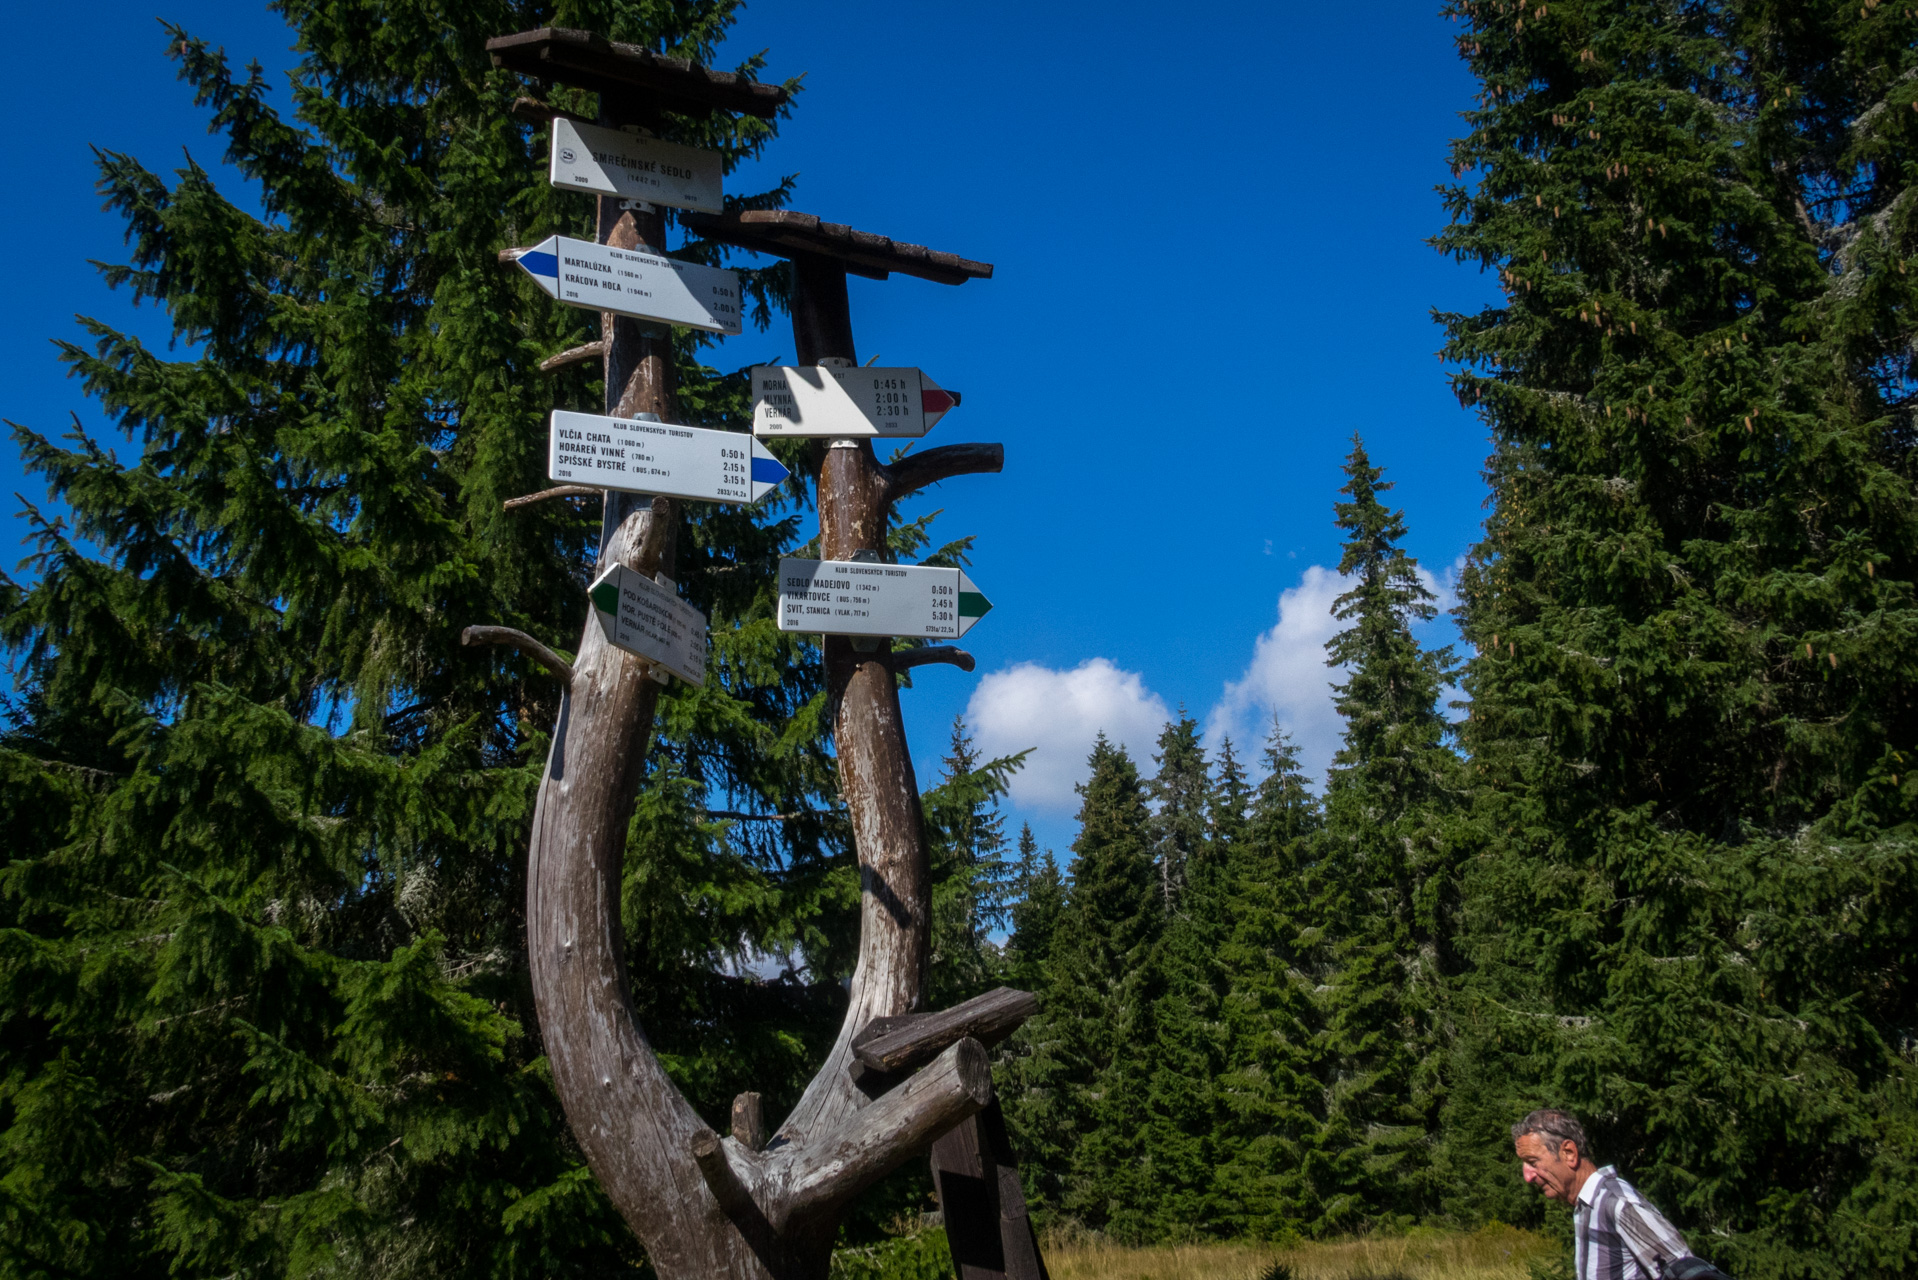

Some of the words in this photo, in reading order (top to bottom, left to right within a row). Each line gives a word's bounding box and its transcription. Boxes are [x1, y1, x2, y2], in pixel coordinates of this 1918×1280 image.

[592, 152, 656, 173] SMREČINSKÉ
[660, 164, 691, 180] SEDLO
[610, 251, 623, 260] KLUB
[625, 255, 659, 267] SLOVENSKÝCH
[564, 257, 612, 274] MARTALÚZKA
[565, 274, 598, 288] KRÁĽOVA
[602, 280, 622, 292] HOĽA
[566, 290, 578, 298] 2016
[874, 379, 897, 390] 0:45
[900, 379, 906, 389] h
[876, 393, 899, 403] 2:00
[902, 393, 907, 403] h
[764, 405, 791, 418] VERNÁR
[876, 406, 899, 416] 2:30
[903, 406, 908, 416] h
[559, 429, 582, 440] VLČIA
[587, 432, 611, 444] CHATA
[630, 424, 667, 435] SLOVENSKÝCH
[669, 430, 693, 438] TURISTOV
[559, 442, 597, 454] HORÁREŇ
[601, 446, 626, 458] VINNÉ
[721, 448, 738, 459] 0:50
[740, 452, 745, 460] h
[558, 455, 593, 468] SPIŠSKÉ
[597, 460, 626, 472] BYSTRÉ
[723, 462, 739, 472] 2:15
[740, 464, 745, 473] h
[558, 470, 572, 478] 2016
[724, 475, 739, 485] 3:15
[741, 477, 745, 485] h
[850, 567, 883, 576] SLOVENSKÝCH
[885, 569, 907, 577] TURISTOV
[787, 578, 810, 588] SEDLO
[814, 579, 850, 590] MADEJOVO
[932, 585, 947, 595] 0:50
[948, 586, 952, 595] h
[623, 588, 637, 601] POD
[787, 591, 830, 602] VIKARTOVCE
[787, 604, 804, 614] SVIT,
[806, 606, 830, 615] STANICA
[932, 599, 948, 608] 2:45
[948, 600, 953, 608] h
[622, 602, 636, 616] HOR.
[638, 609, 656, 626] PUSTÉ
[932, 611, 948, 621] 5:30
[949, 612, 953, 621] h
[621, 616, 645, 632] VERNÁR
